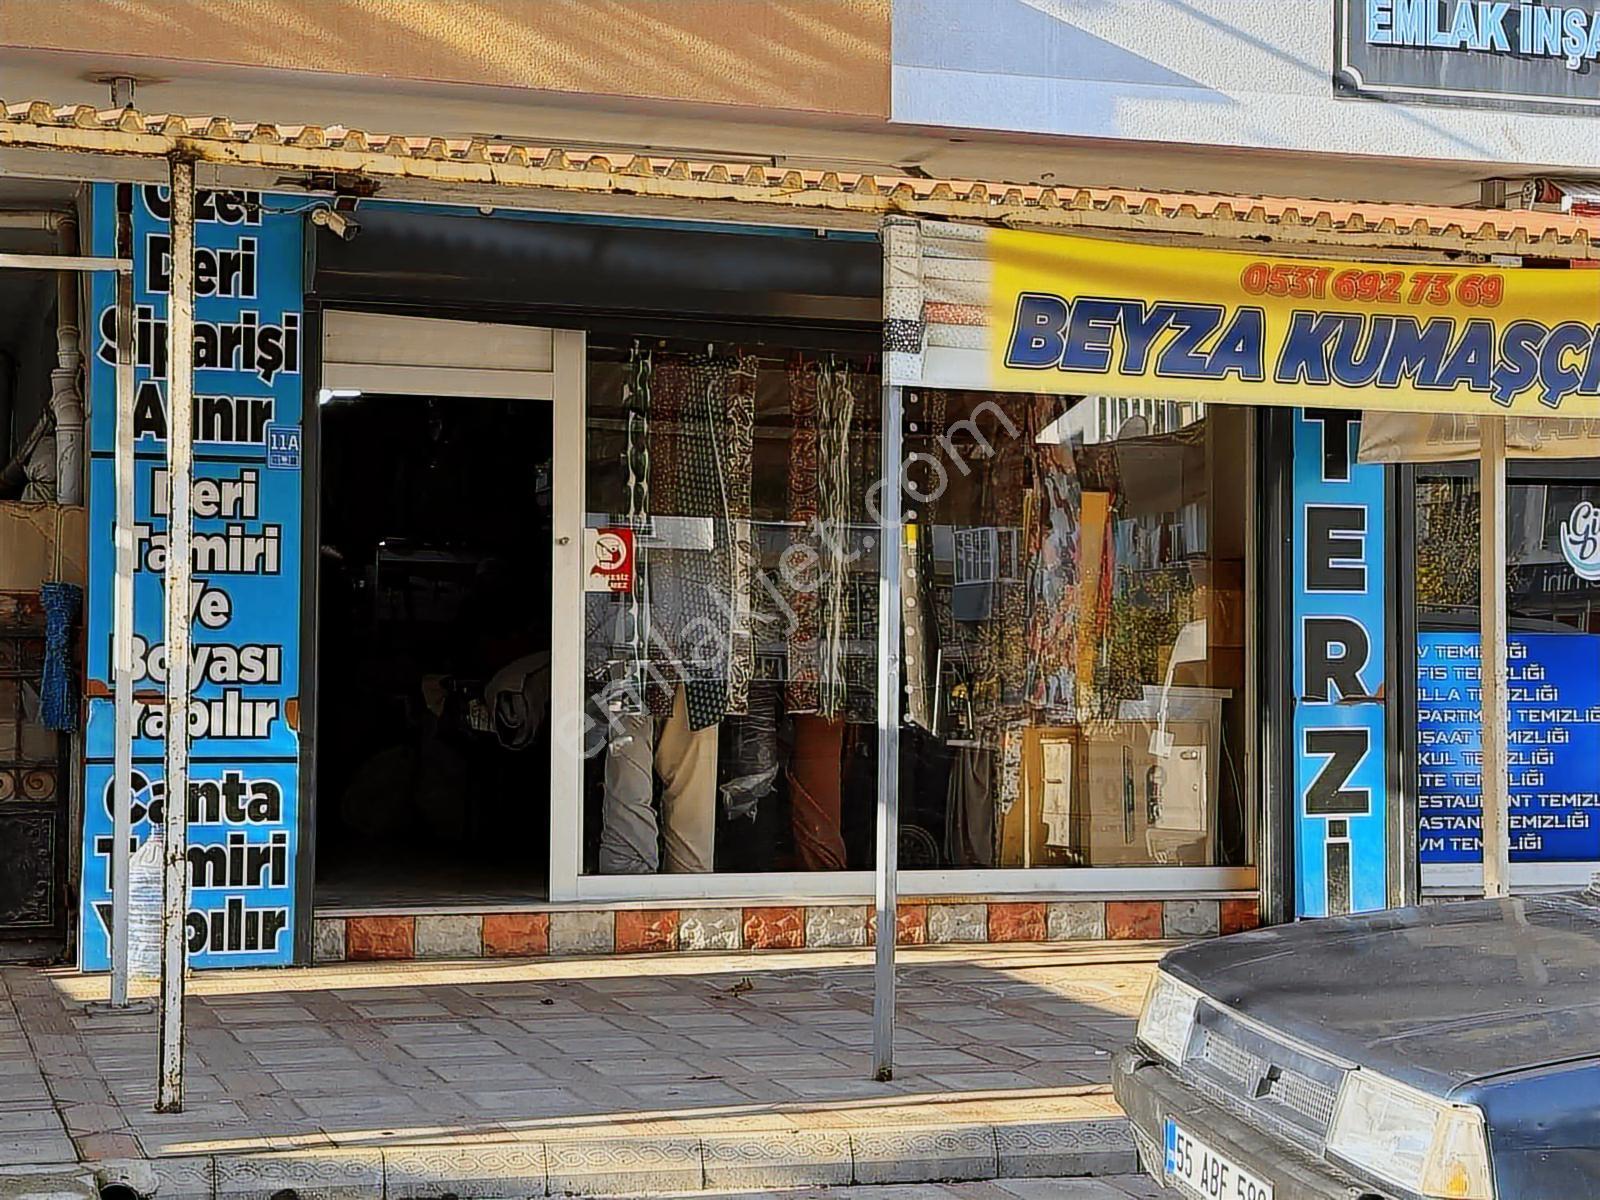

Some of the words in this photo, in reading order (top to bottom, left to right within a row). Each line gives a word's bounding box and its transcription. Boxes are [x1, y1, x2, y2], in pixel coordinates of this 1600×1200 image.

[1366, 0, 1510, 51] EMLAK
[146, 233, 257, 299] Deri
[1241, 262, 1334, 299] 0531
[1331, 269, 1404, 304] 692
[1407, 272, 1457, 306] 73
[1455, 274, 1506, 307] 69
[1003, 292, 1266, 381] BEYZA
[133, 381, 276, 445] Aınır
[271, 434, 299, 451] 11A
[1418, 752, 1457, 765] KUL
[94, 830, 290, 891] Tmiri
[1176, 1134, 1193, 1177] 55
